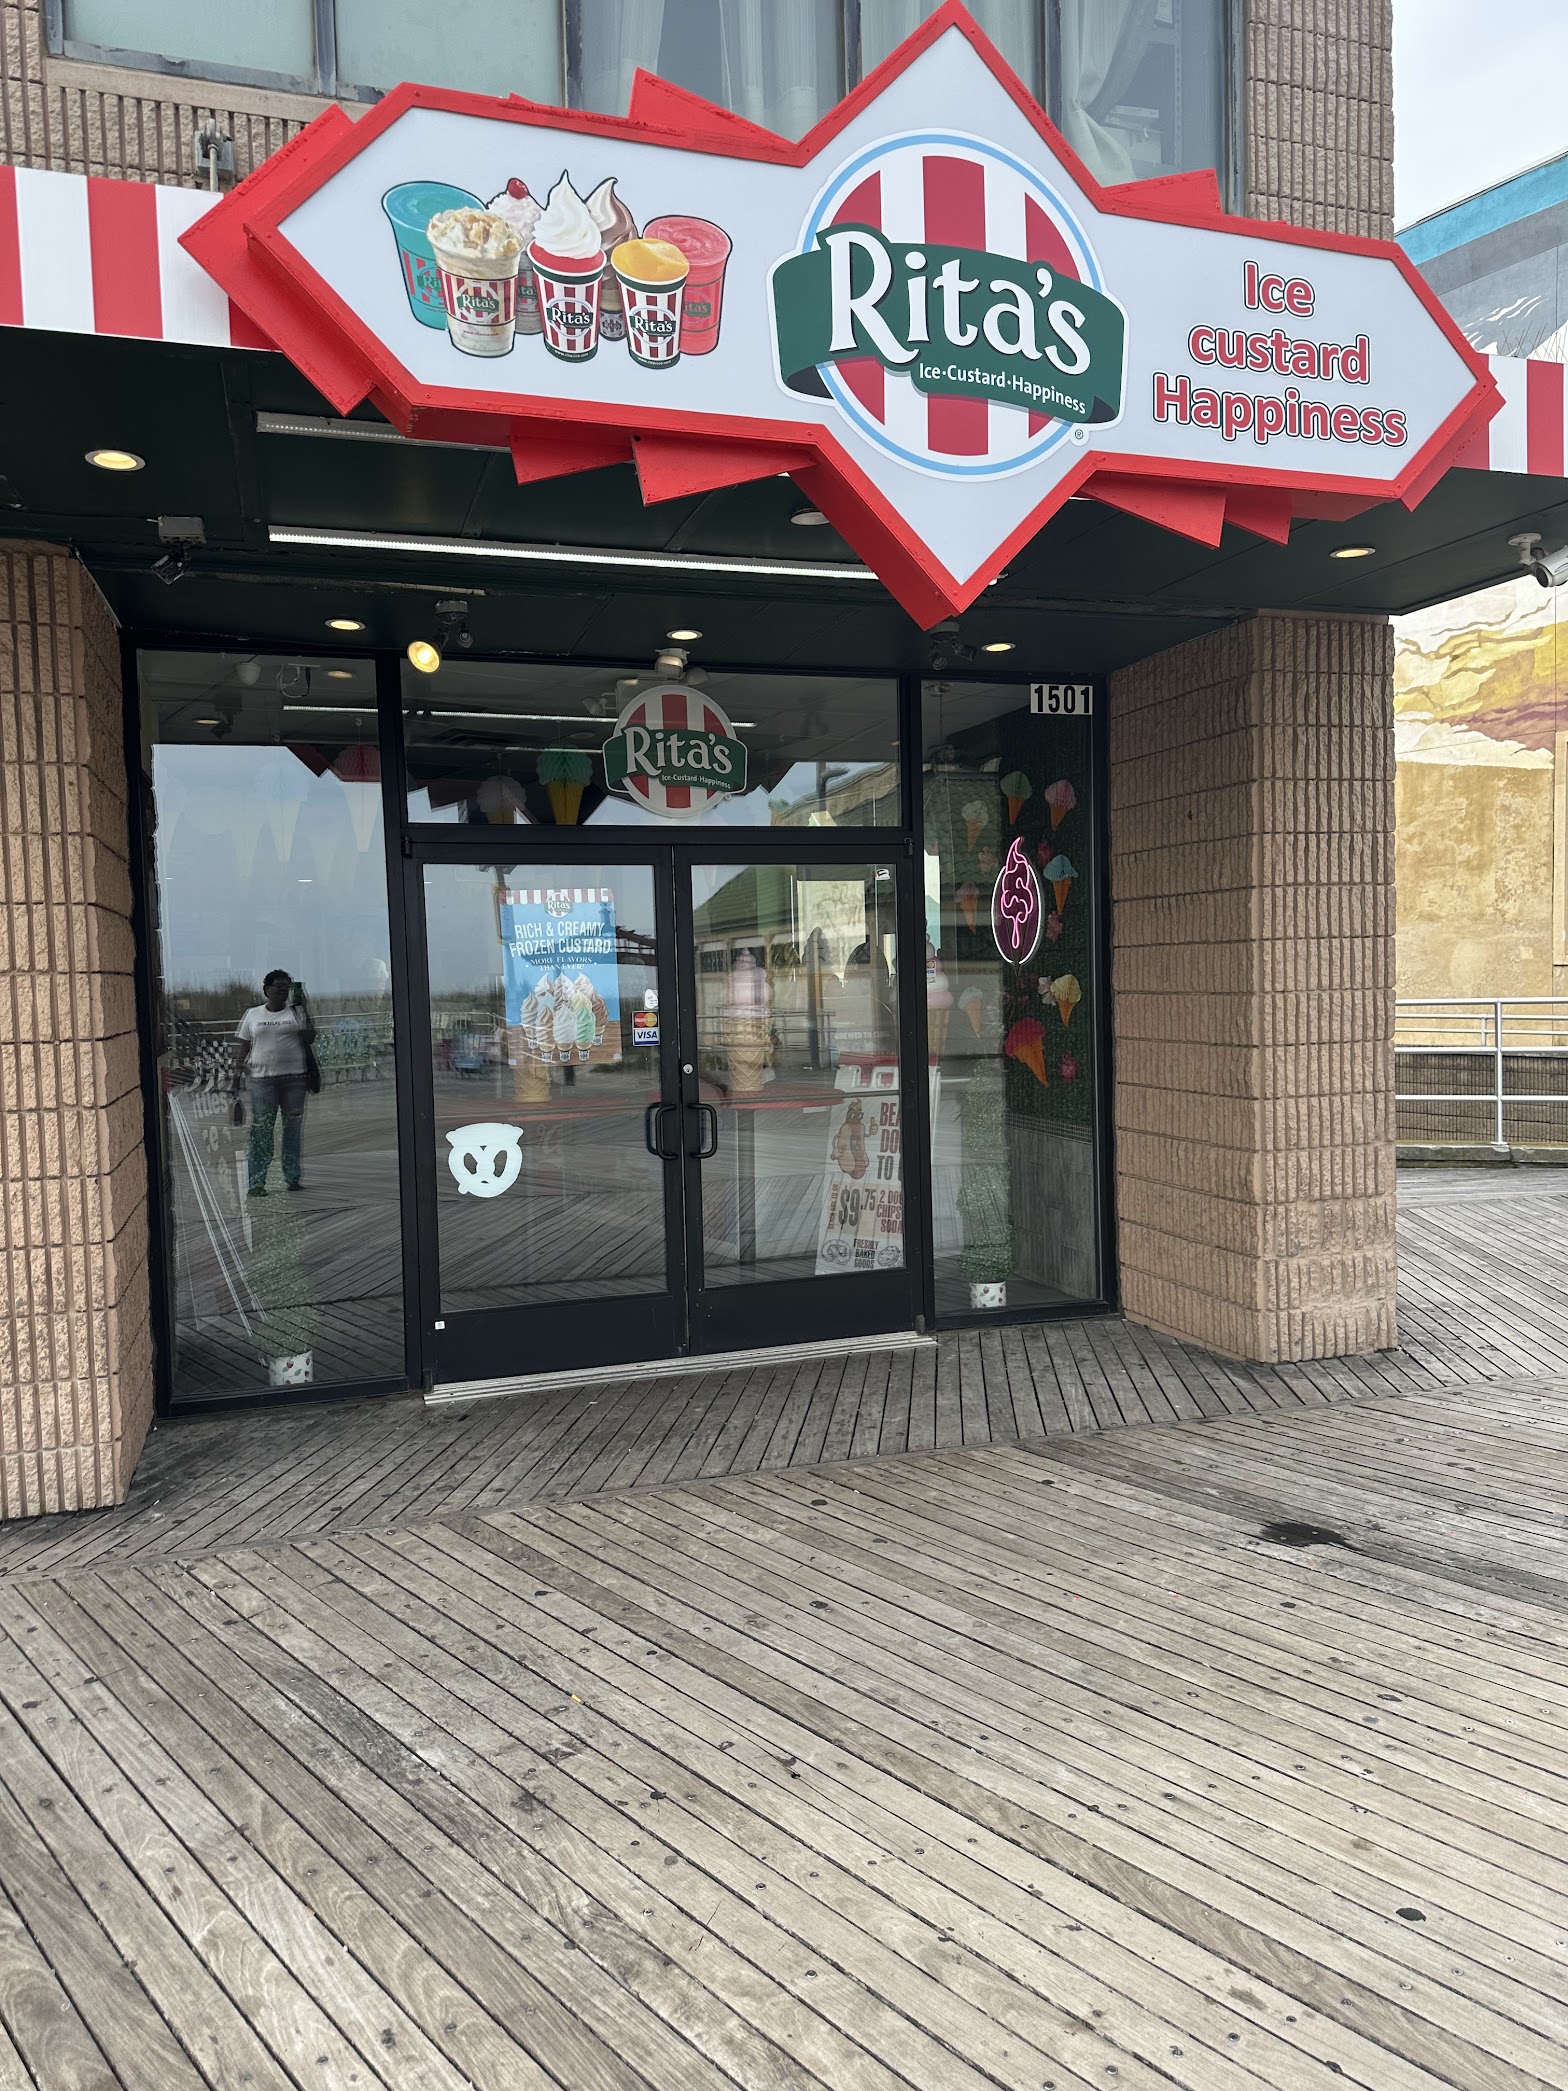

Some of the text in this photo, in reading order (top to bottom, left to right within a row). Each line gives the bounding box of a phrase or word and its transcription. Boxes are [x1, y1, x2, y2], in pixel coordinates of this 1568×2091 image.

[1244, 260, 1316, 318] Ice
[461, 294, 496, 309] Rita's
[825, 231, 1092, 376] Rita's
[551, 307, 591, 325] Rita's
[634, 315, 674, 334] Rita's
[1187, 324, 1371, 385] custard
[1152, 372, 1409, 448] Happiness
[1034, 685, 1090, 713] 1501
[624, 726, 733, 776] Rita's
[547, 899, 571, 911] Rita's
[513, 921, 606, 940] RICH & CREAMY
[508, 938, 612, 958] FROZEN CUSTARD
[530, 956, 593, 965] MORE FLAVORS
[540, 963, 560, 972] THAN
[636, 1030, 658, 1039] VISA
[880, 1128, 900, 1153] DO
[876, 1155, 894, 1180] TO
[880, 1190, 886, 1204] 2
[838, 1185, 877, 1230] $9.75
[853, 1238, 880, 1250] FRESHLY
[854, 1248, 876, 1260] BAKED
